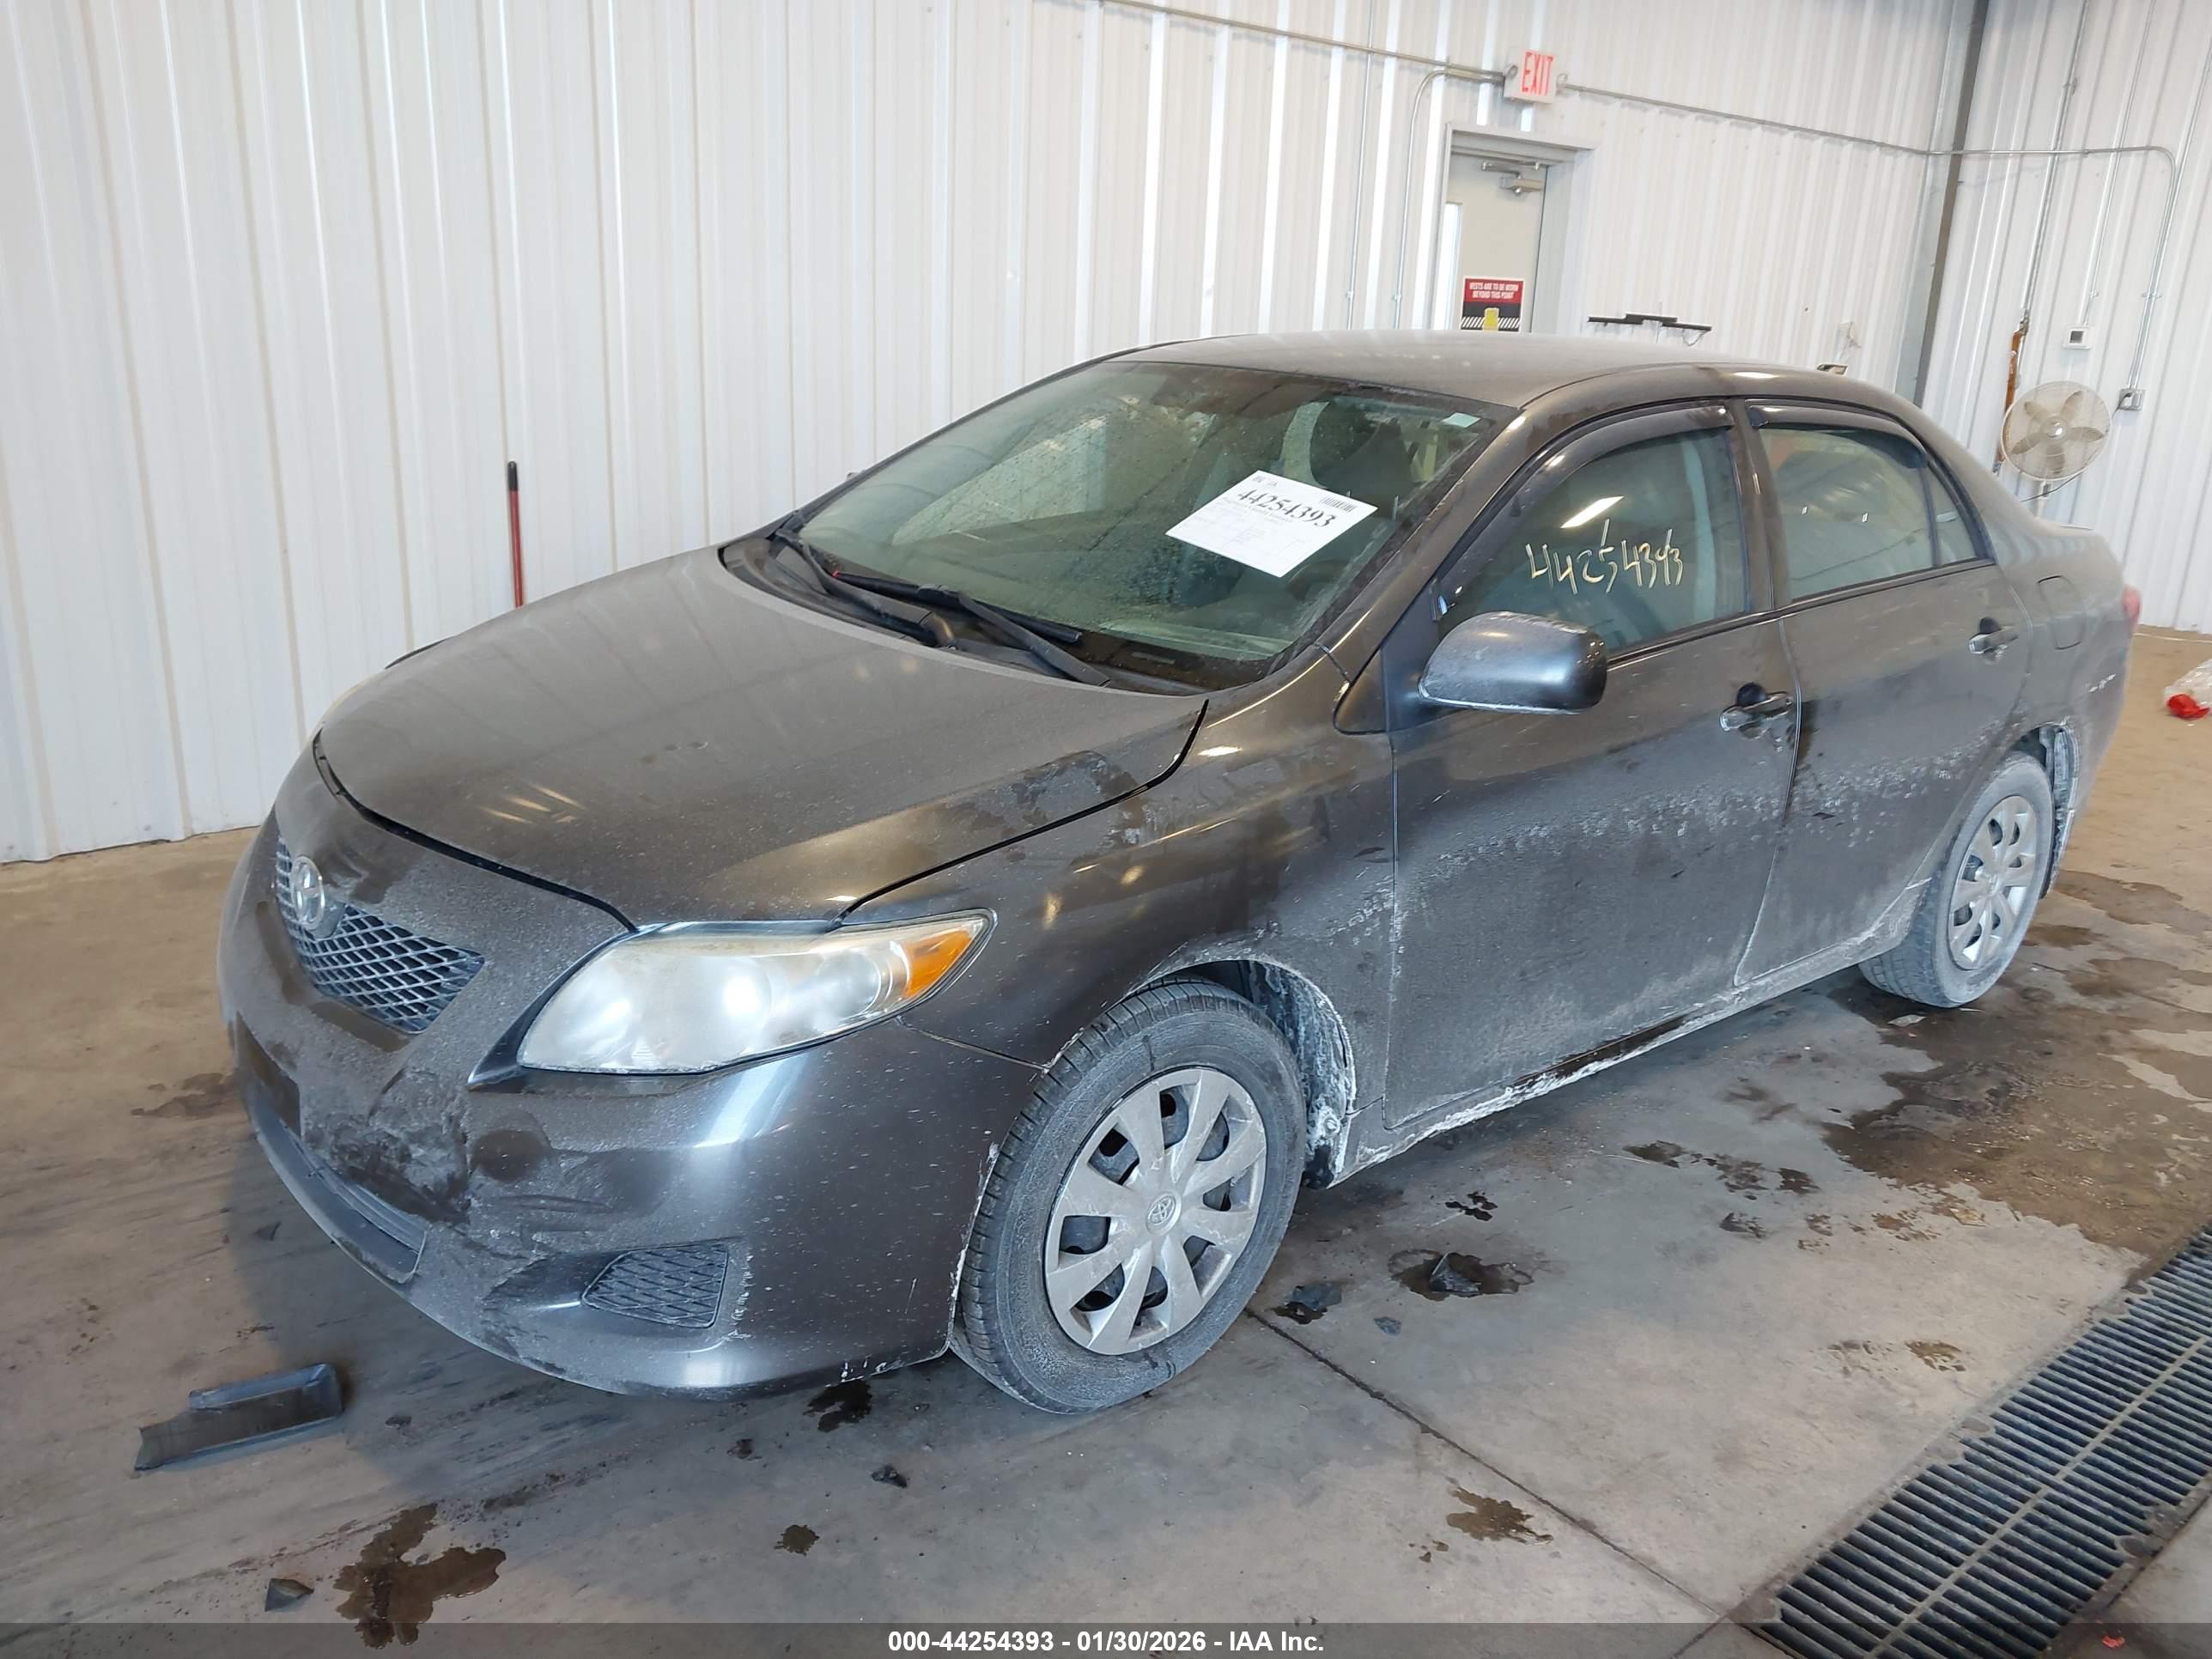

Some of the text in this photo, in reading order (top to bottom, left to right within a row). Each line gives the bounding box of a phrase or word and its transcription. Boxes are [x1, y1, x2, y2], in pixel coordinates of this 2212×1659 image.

[1522, 52, 1553, 96] EXIT
[1473, 290, 1491, 299] BEYOND
[1237, 489, 1337, 528] 44254393
[1525, 519, 1683, 594] 44254393
